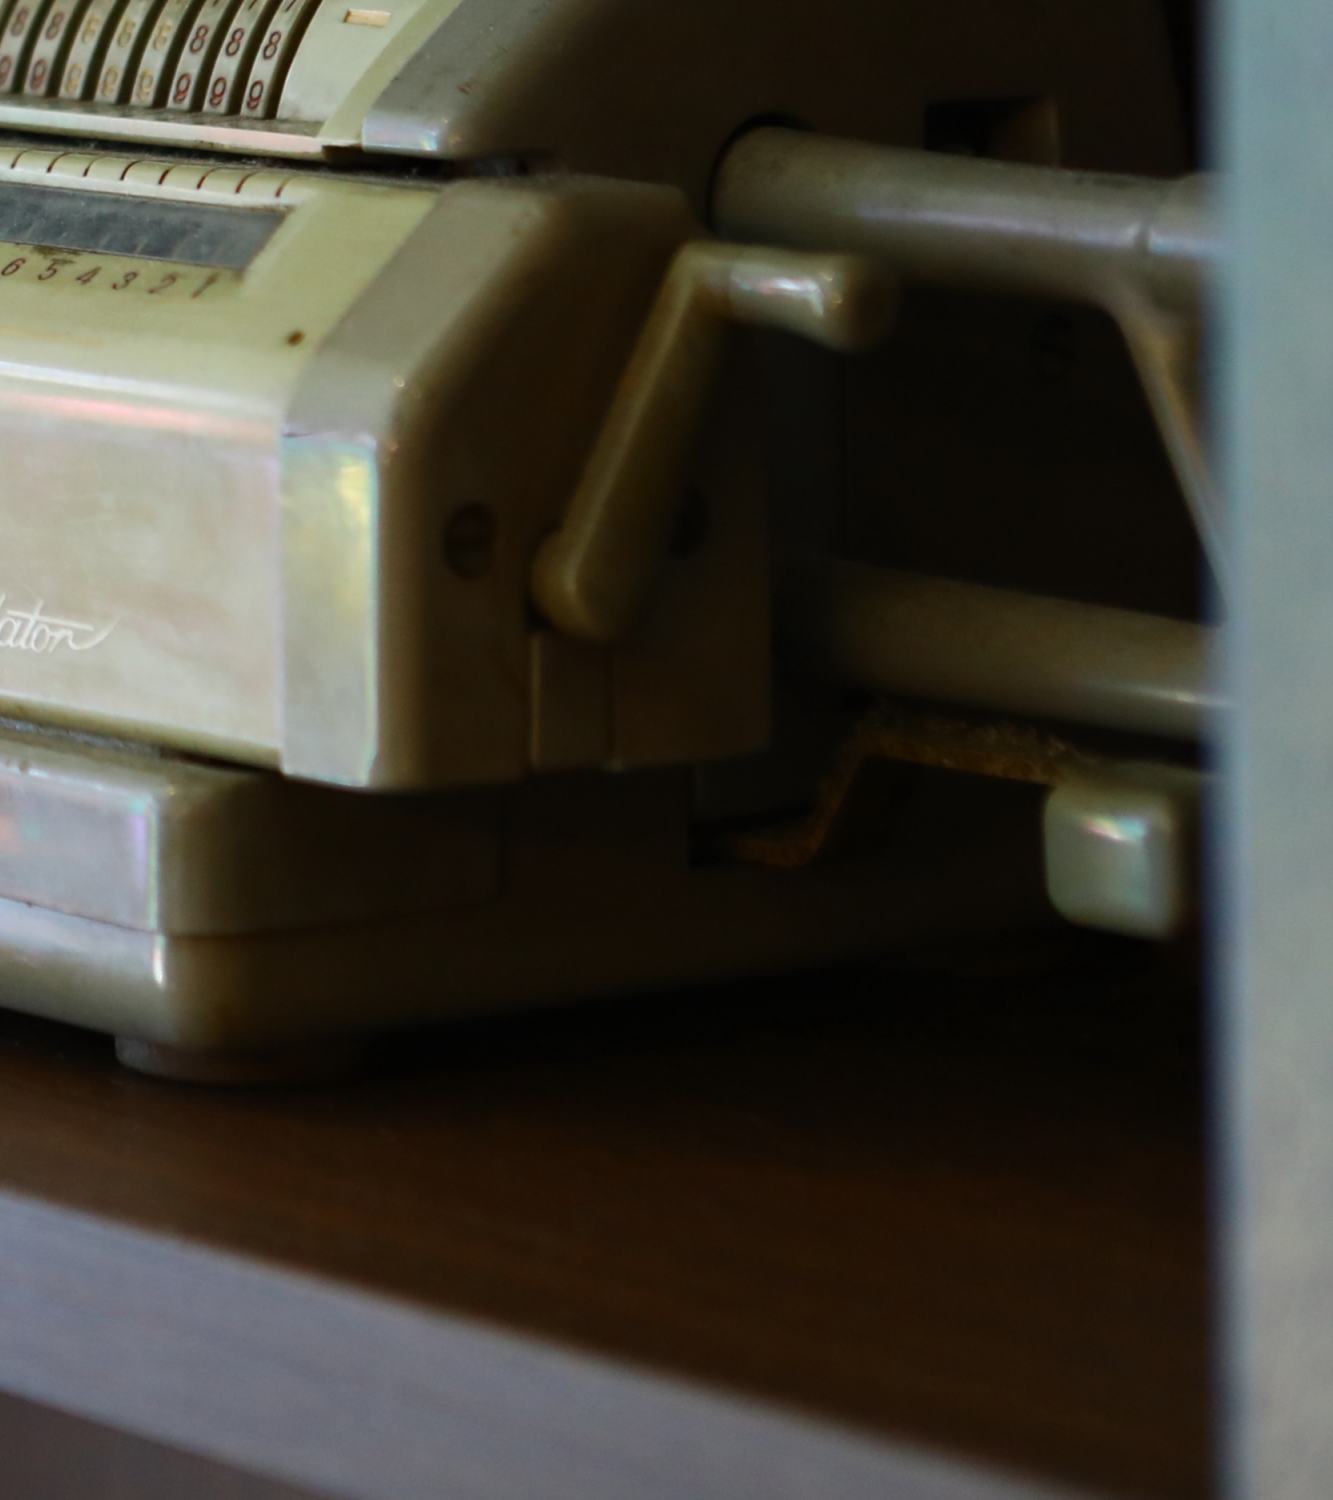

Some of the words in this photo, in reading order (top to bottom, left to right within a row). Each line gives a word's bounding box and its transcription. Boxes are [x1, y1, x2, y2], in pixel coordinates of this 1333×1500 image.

[10, 7, 29, 37] 8
[45, 11, 65, 40] 8
[189, 24, 209, 54] 8
[225, 27, 245, 57] 8
[263, 30, 282, 60] 8
[30, 58, 47, 90] 9
[173, 73, 192, 104] 9
[209, 76, 227, 108] 9
[247, 80, 264, 111] 9
[1, 257, 26, 277] 6
[37, 260, 62, 281] 5
[76, 266, 102, 285] 4
[112, 271, 139, 290] 3
[148, 272, 178, 294] 2
[192, 271, 220, 299] 1
